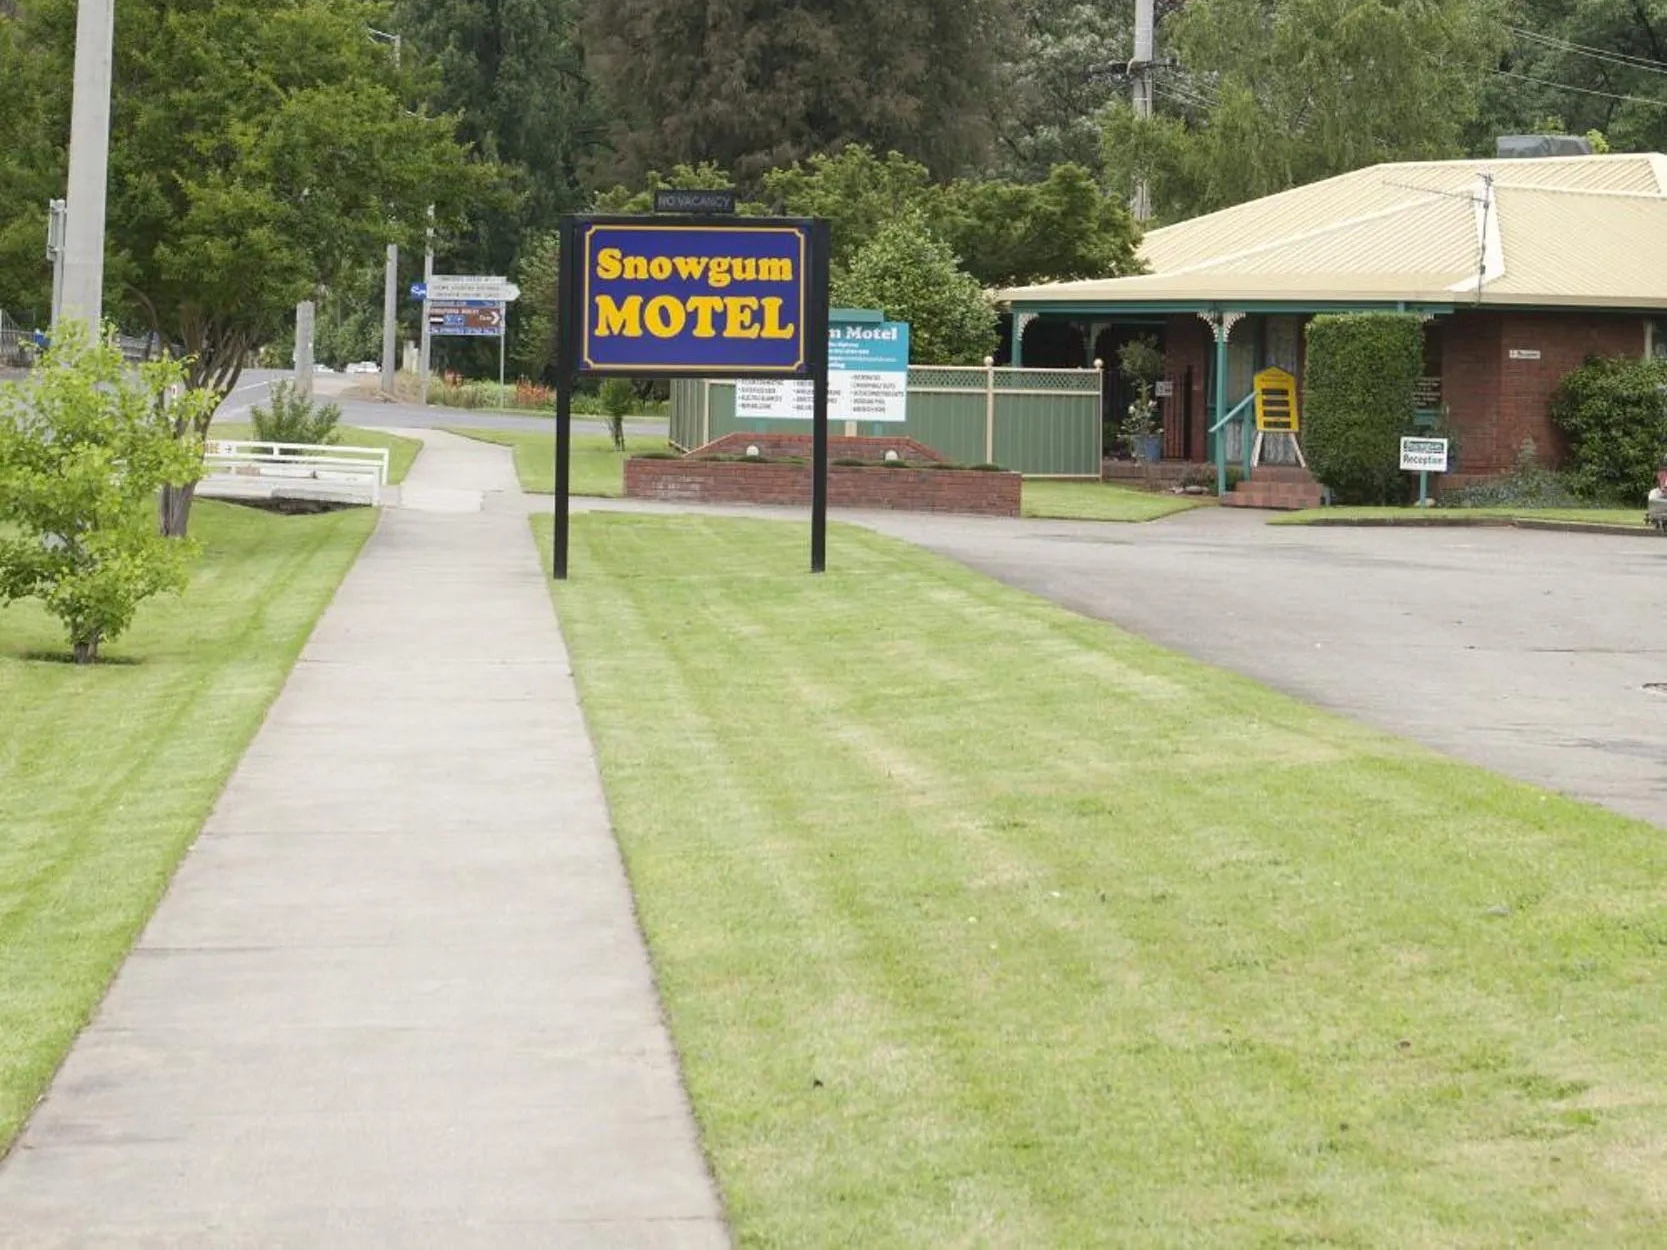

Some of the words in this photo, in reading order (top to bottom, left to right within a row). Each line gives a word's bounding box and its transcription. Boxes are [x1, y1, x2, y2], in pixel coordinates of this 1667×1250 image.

[596, 248, 793, 287] Snowgum
[594, 295, 795, 339] MOTEL
[846, 326, 898, 341] Motel
